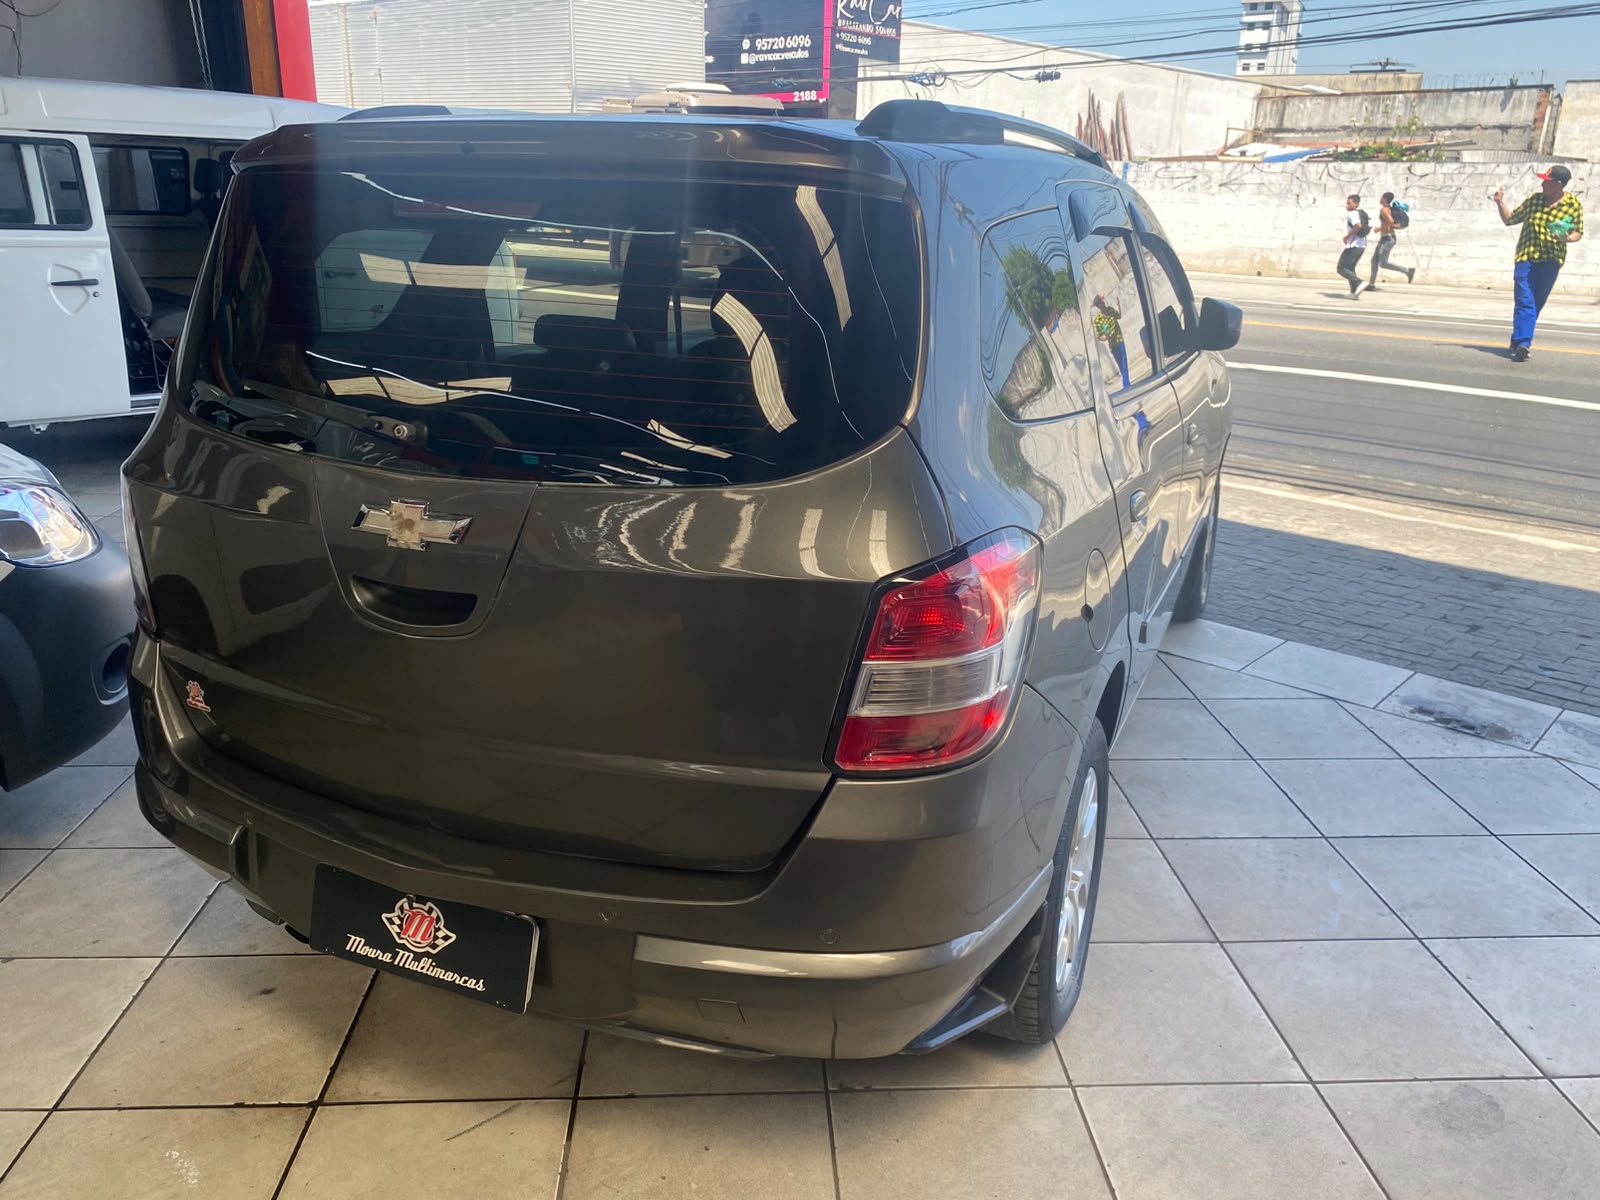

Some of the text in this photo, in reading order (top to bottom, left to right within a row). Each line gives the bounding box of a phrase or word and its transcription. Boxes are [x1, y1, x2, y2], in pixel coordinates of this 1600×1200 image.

[755, 34, 812, 51] 95720 6096
[793, 90, 817, 102] 2188
[346, 933, 487, 992] Moura Multimarcas
